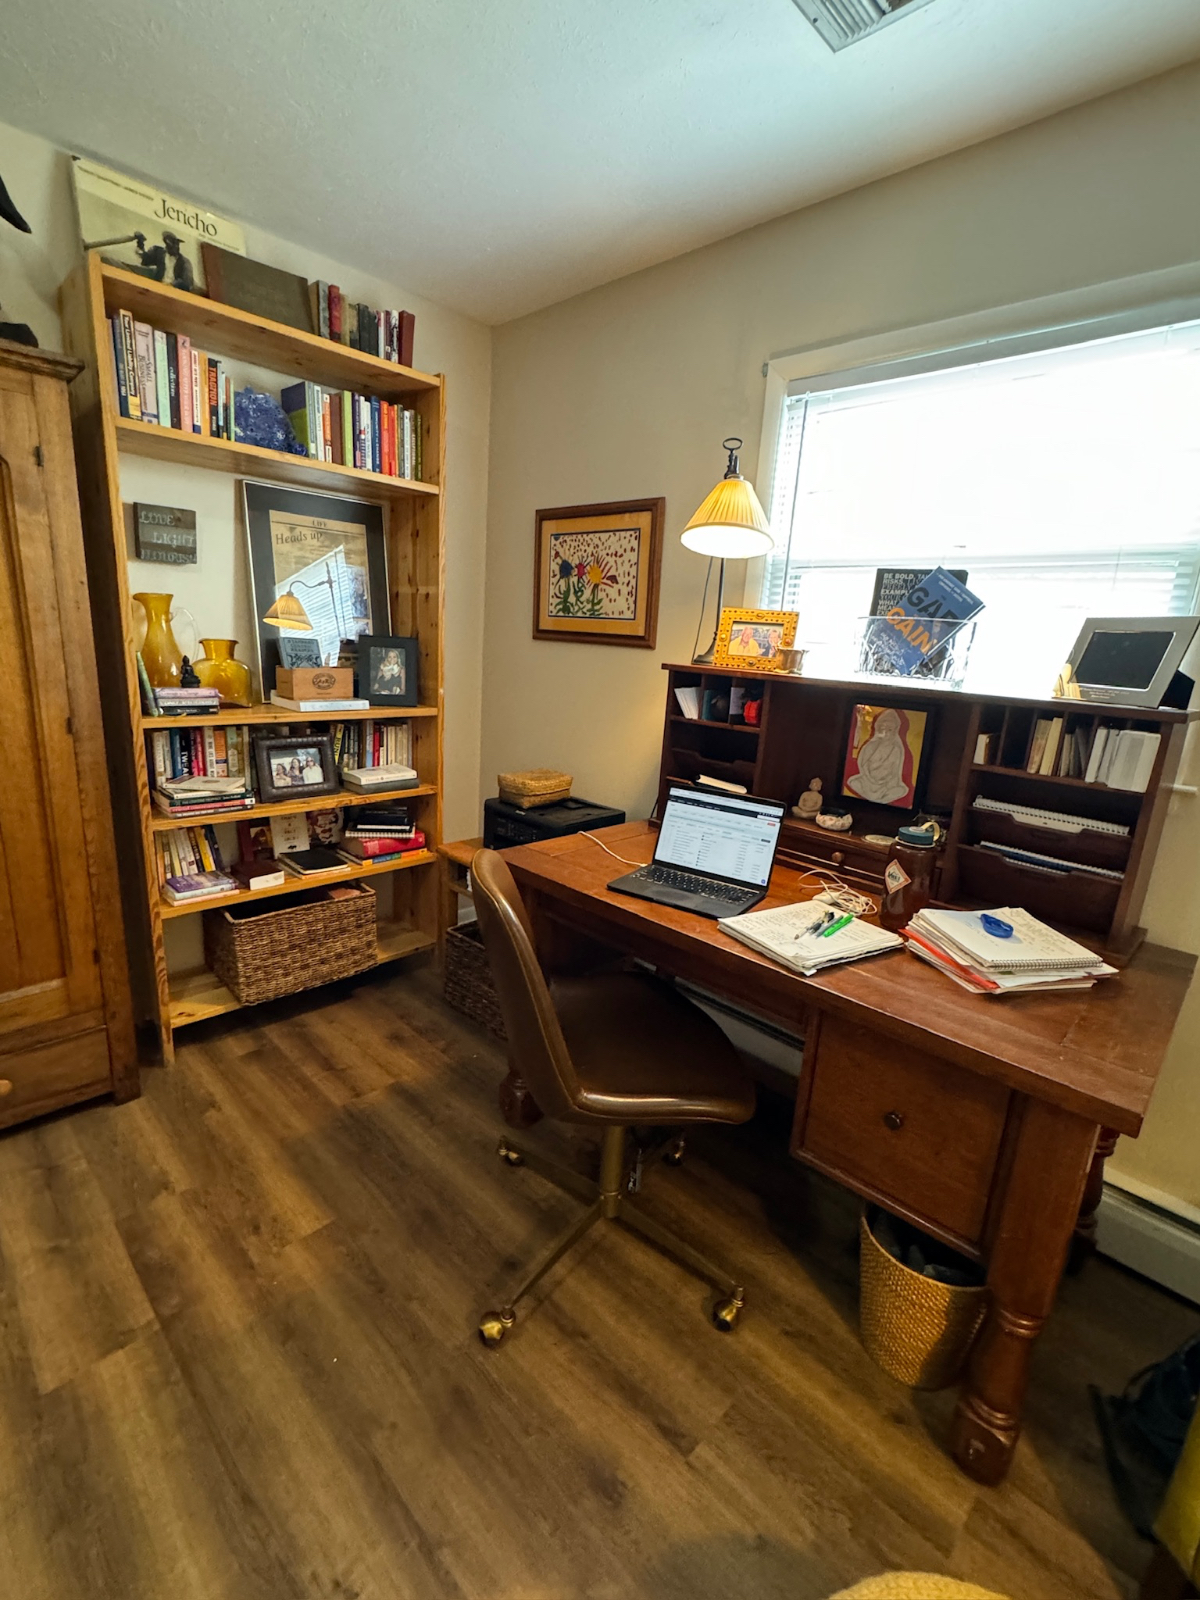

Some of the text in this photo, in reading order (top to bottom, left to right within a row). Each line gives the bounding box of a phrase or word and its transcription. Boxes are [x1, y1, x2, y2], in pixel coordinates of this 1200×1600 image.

[154, 199, 217, 236] Jericho
[208, 367, 218, 406] TRACTION
[275, 531, 323, 545] Heads up
[887, 607, 935, 654] GAIN
